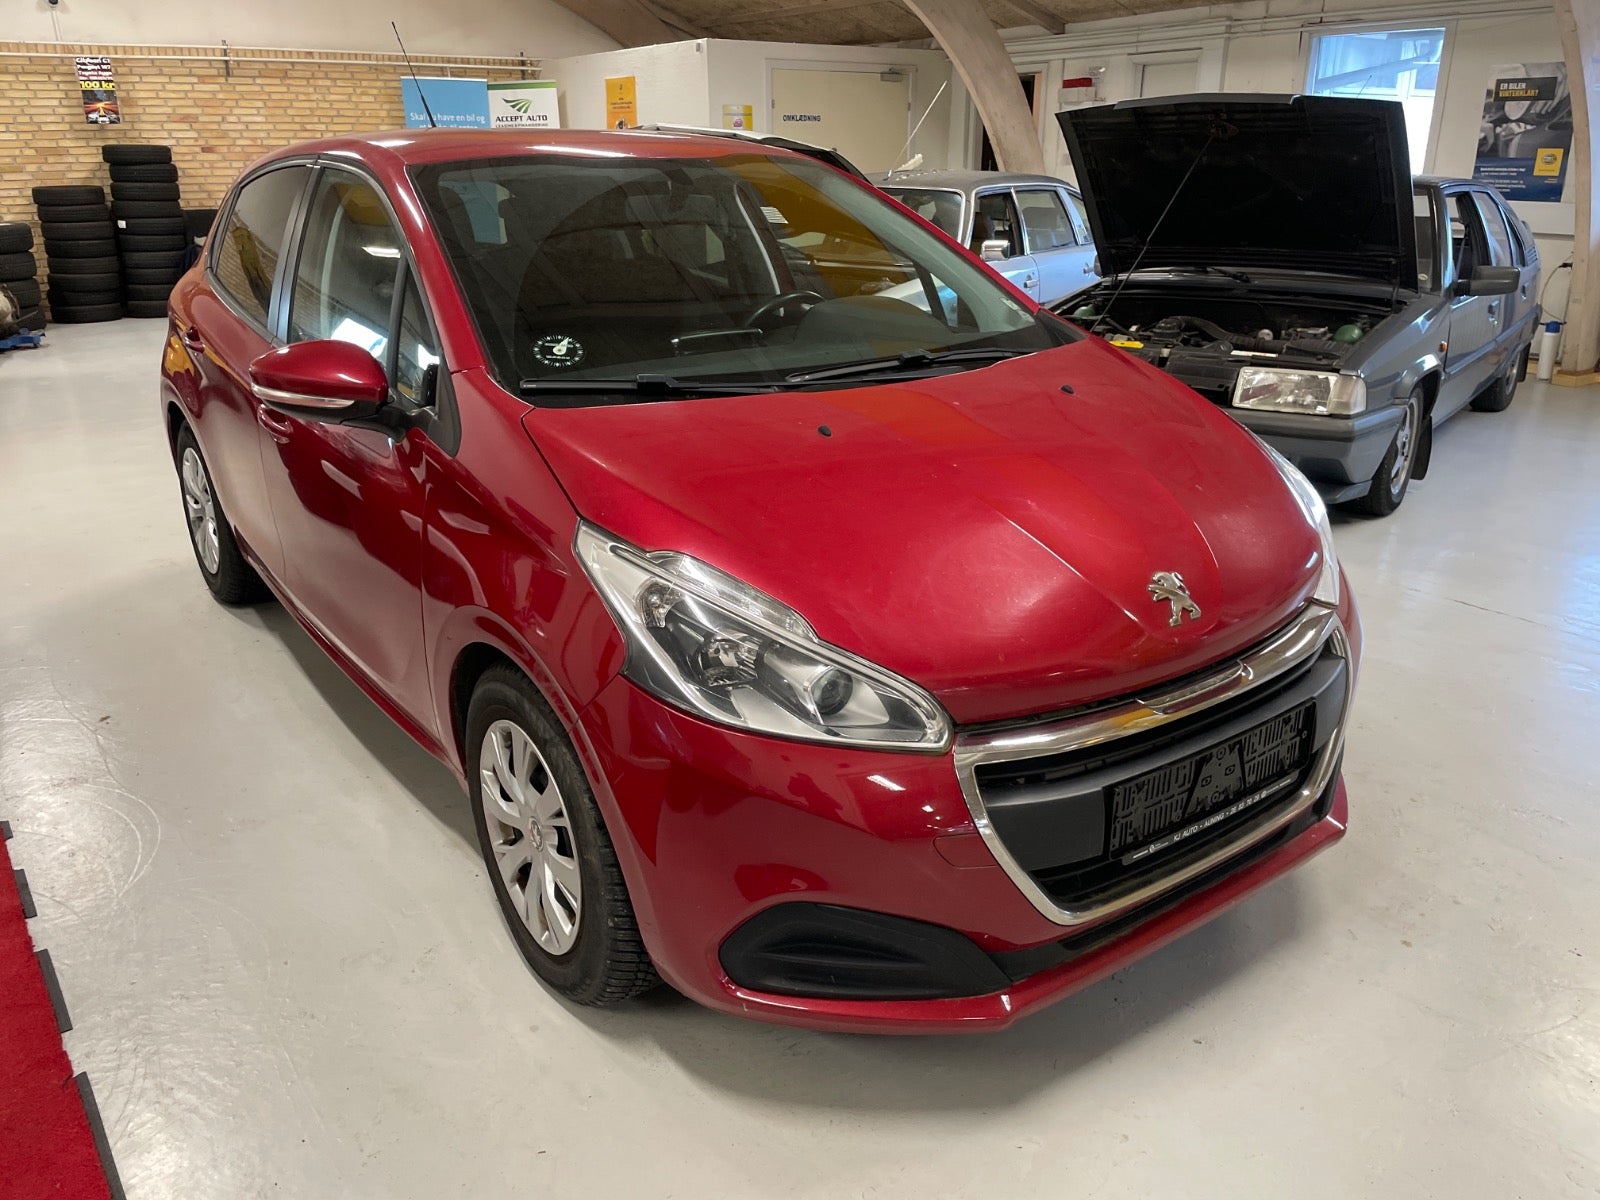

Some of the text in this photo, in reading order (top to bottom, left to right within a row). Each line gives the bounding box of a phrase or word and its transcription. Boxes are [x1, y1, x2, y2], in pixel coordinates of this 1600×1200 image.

[80, 81, 116, 89] 100 kr
[410, 112, 426, 121] Skal
[437, 113, 455, 121] have
[466, 113, 475, 122] bil
[476, 115, 486, 124] og
[526, 114, 548, 122] AUTO
[783, 114, 822, 122] OMKLÆDNING
[1173, 833, 1182, 842] KJ
[1182, 826, 1198, 839] AUTO
